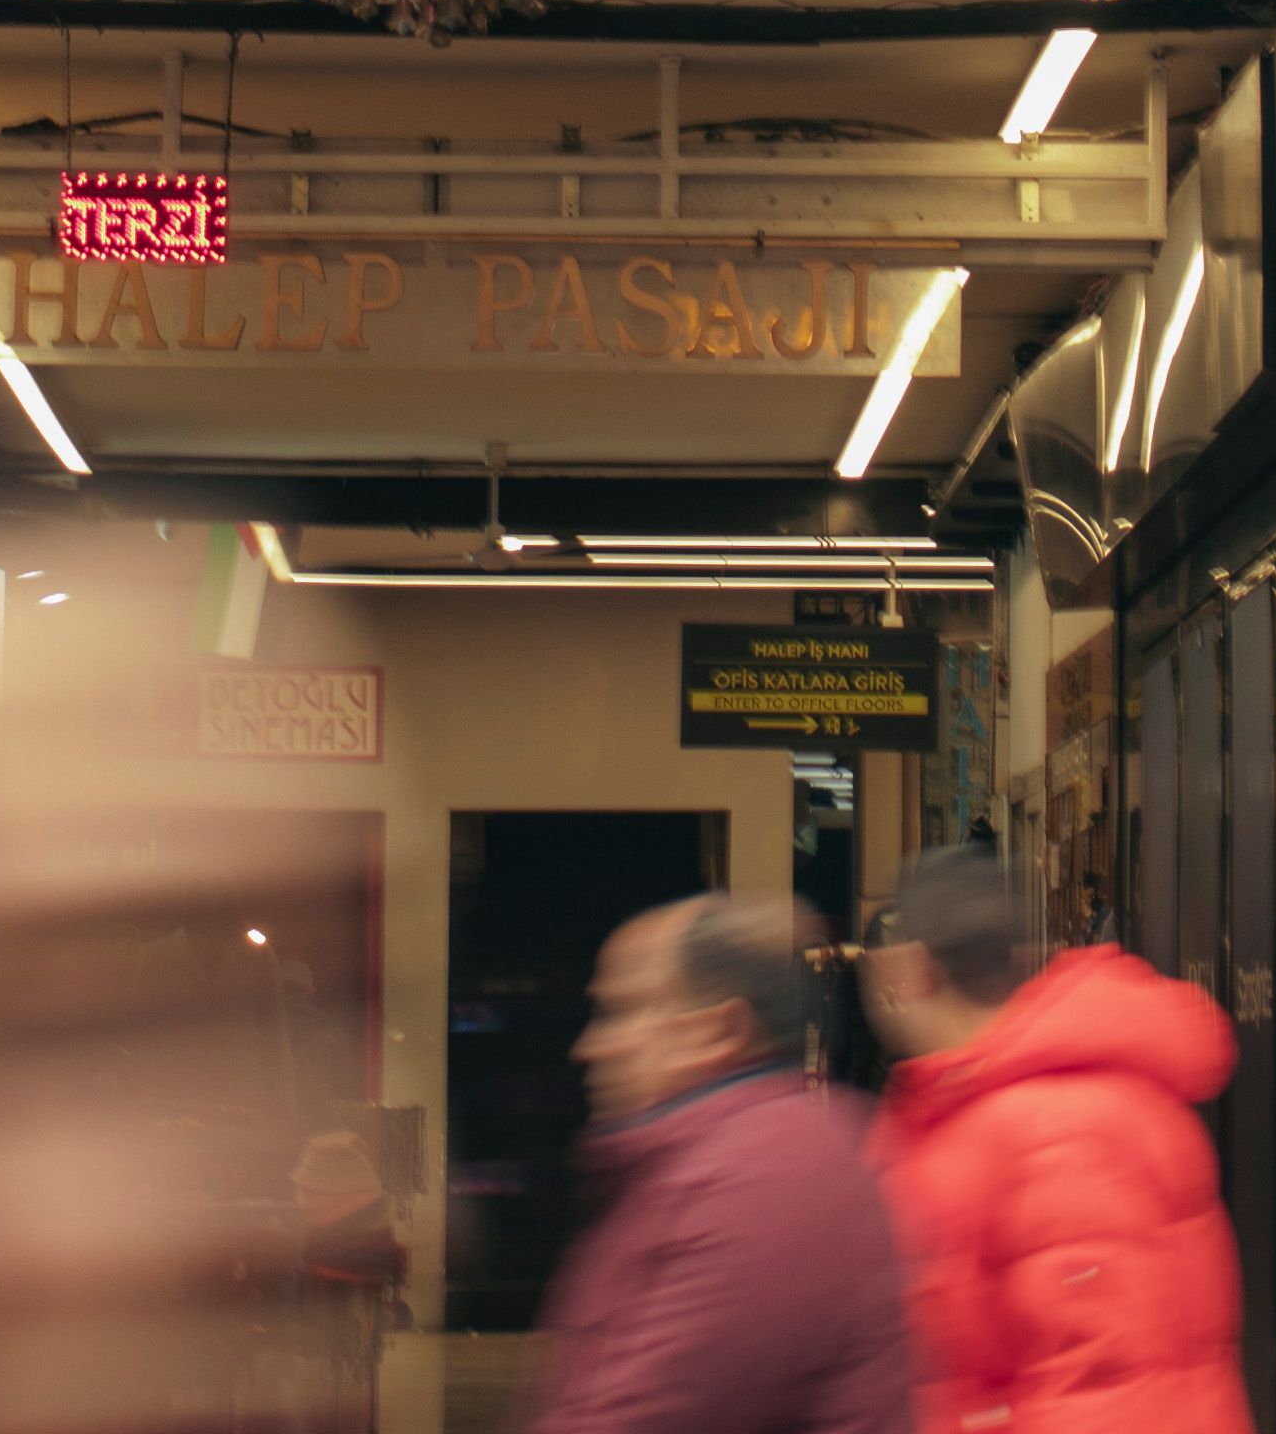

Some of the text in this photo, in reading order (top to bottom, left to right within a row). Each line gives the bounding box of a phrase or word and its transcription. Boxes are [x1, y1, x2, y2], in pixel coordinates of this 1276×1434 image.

[63, 189, 212, 247] TERZİ
[4, 251, 407, 353] HALEP
[752, 641, 806, 659] HALEP
[764, 672, 850, 691] KATLARA
[713, 696, 905, 712] ENTER TO OFFICE FLOORS
